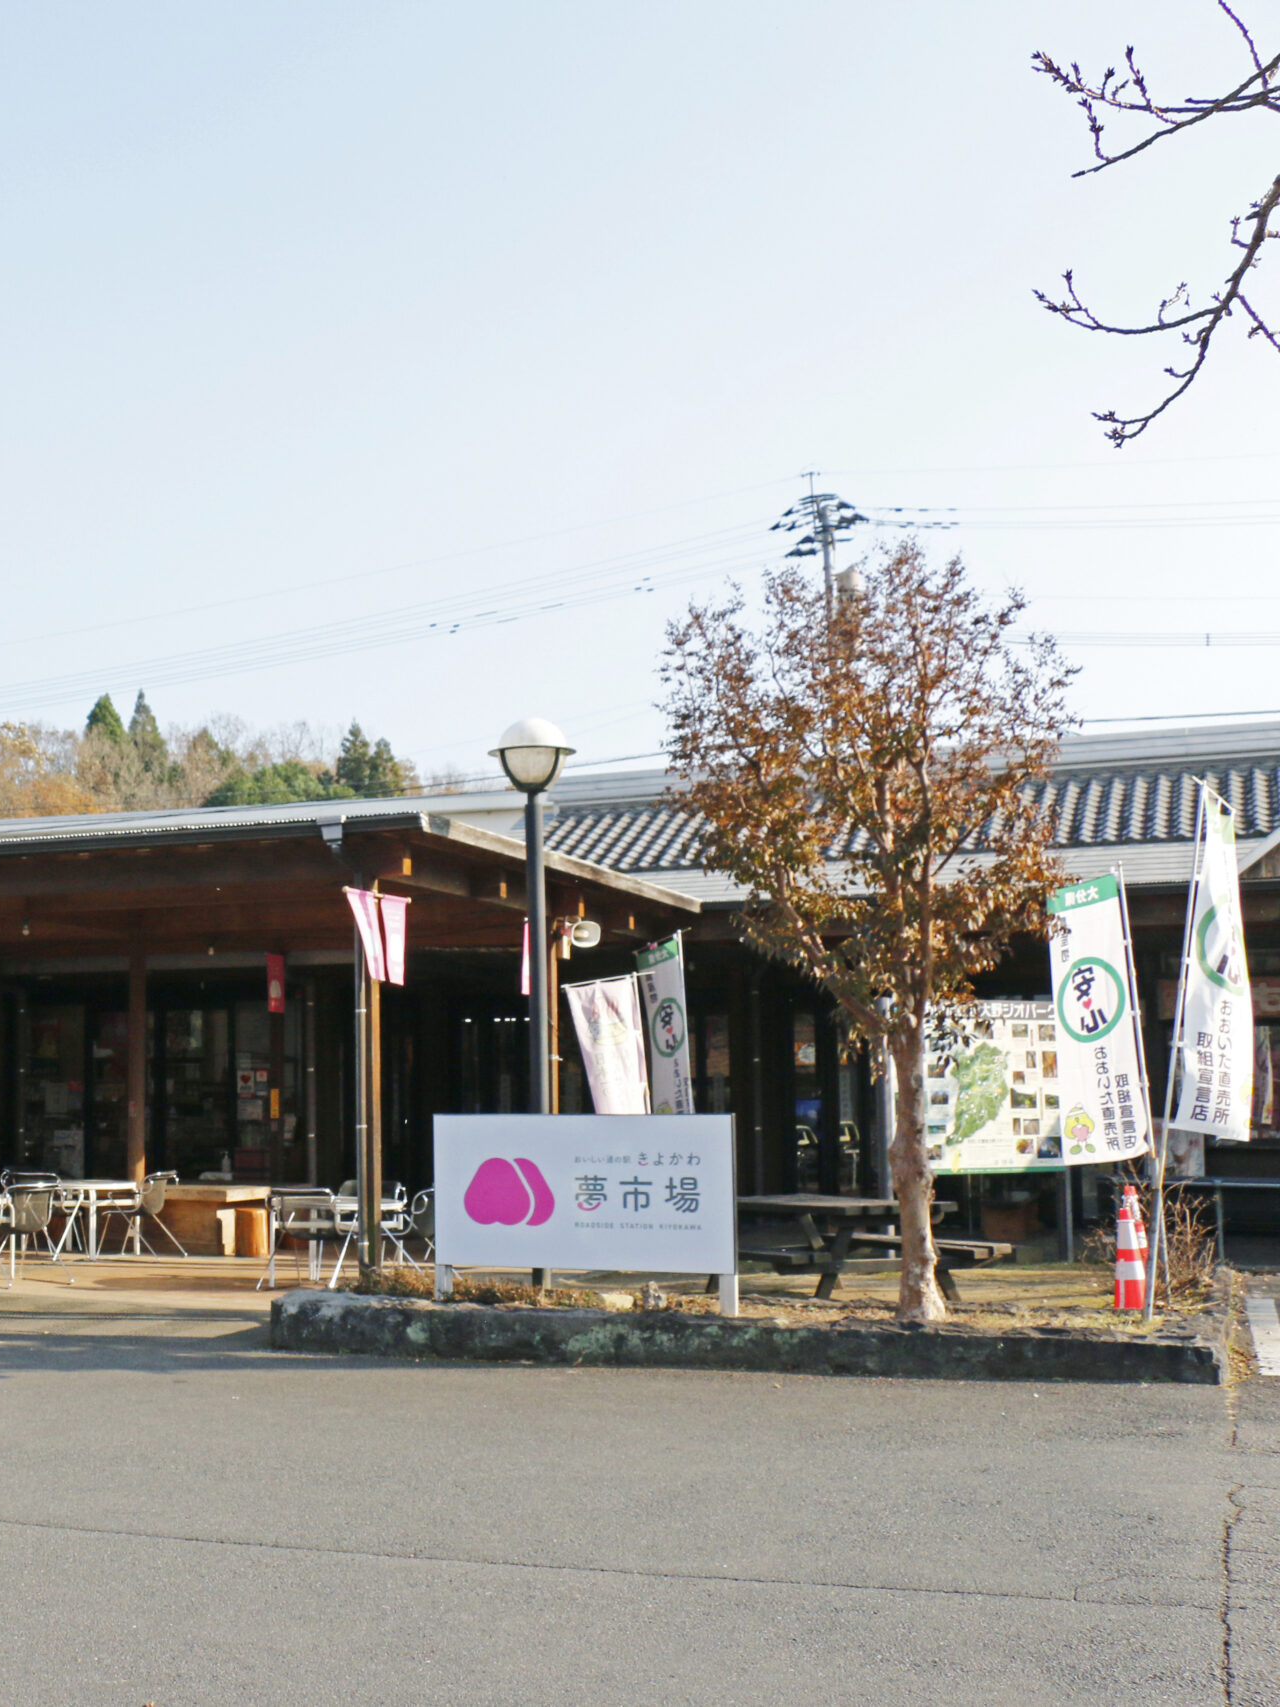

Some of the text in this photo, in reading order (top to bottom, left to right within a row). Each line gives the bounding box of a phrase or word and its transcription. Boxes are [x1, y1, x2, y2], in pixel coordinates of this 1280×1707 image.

[1189, 1031, 1214, 1122] 取組宣言店
[1211, 999, 1234, 1126] おおいた直売所
[637, 1151, 702, 1167] きよかわ
[574, 1174, 702, 1214] 夢市場
